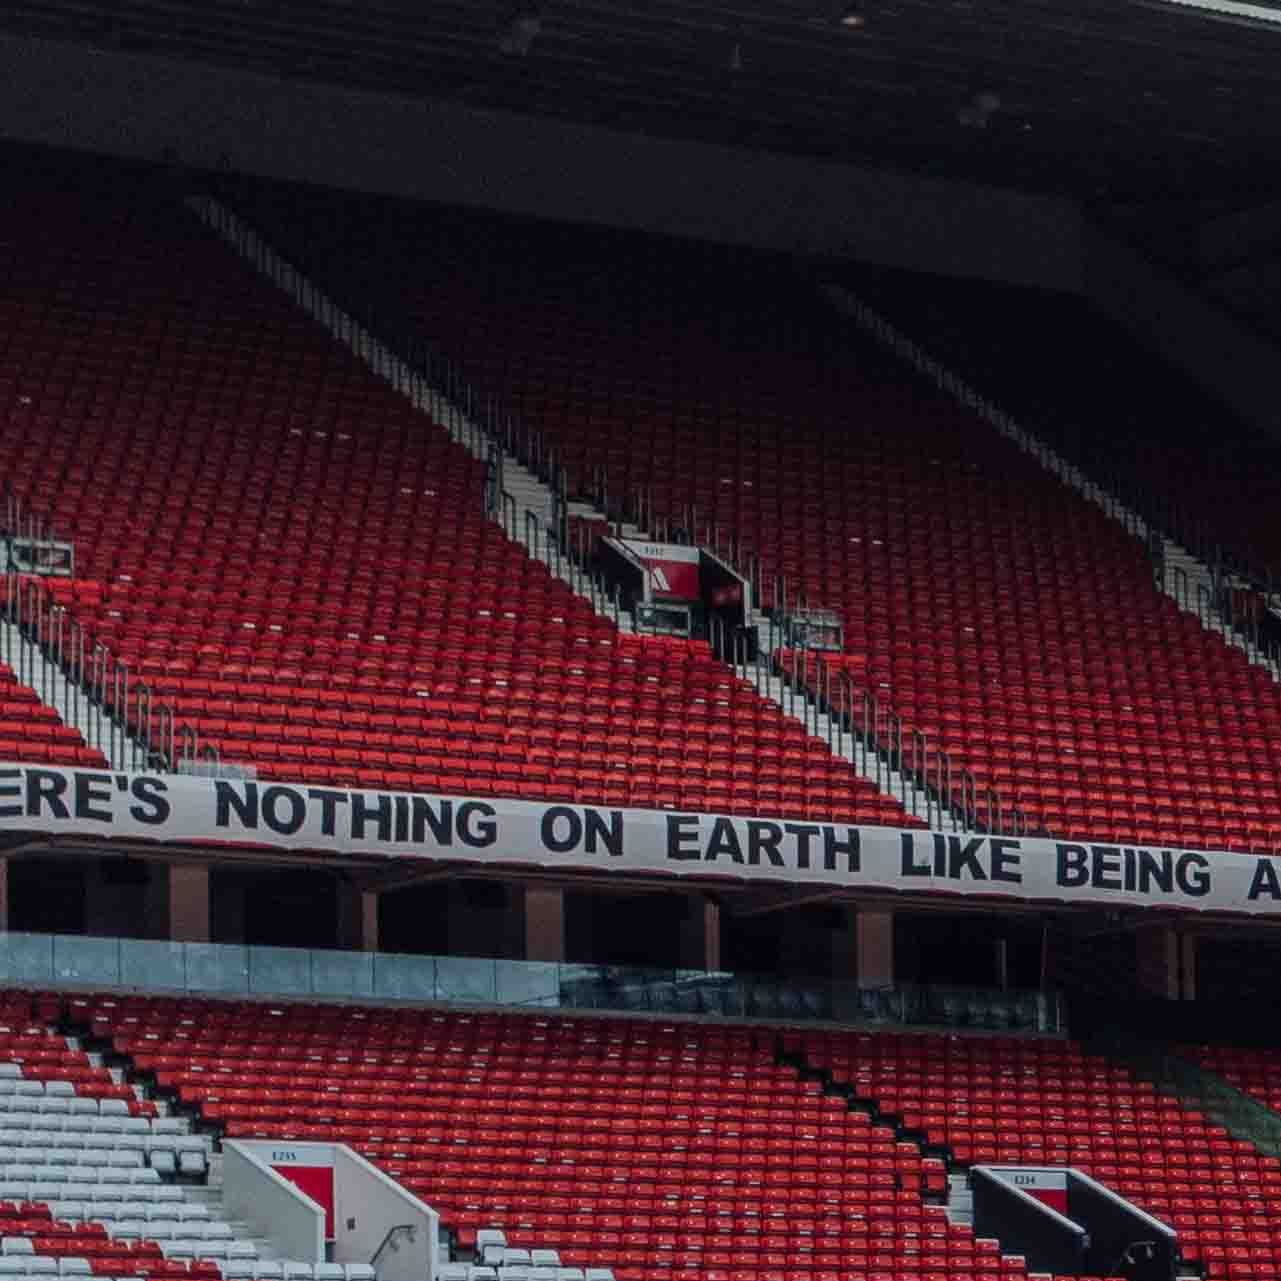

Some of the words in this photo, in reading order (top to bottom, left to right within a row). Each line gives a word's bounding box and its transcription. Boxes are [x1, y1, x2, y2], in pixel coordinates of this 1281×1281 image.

[214, 780, 497, 848] NOTHING
[541, 806, 624, 857] ON
[666, 814, 861, 873] EARTH
[901, 832, 1022, 883] LIKE
[1056, 843, 1211, 897] BEING
